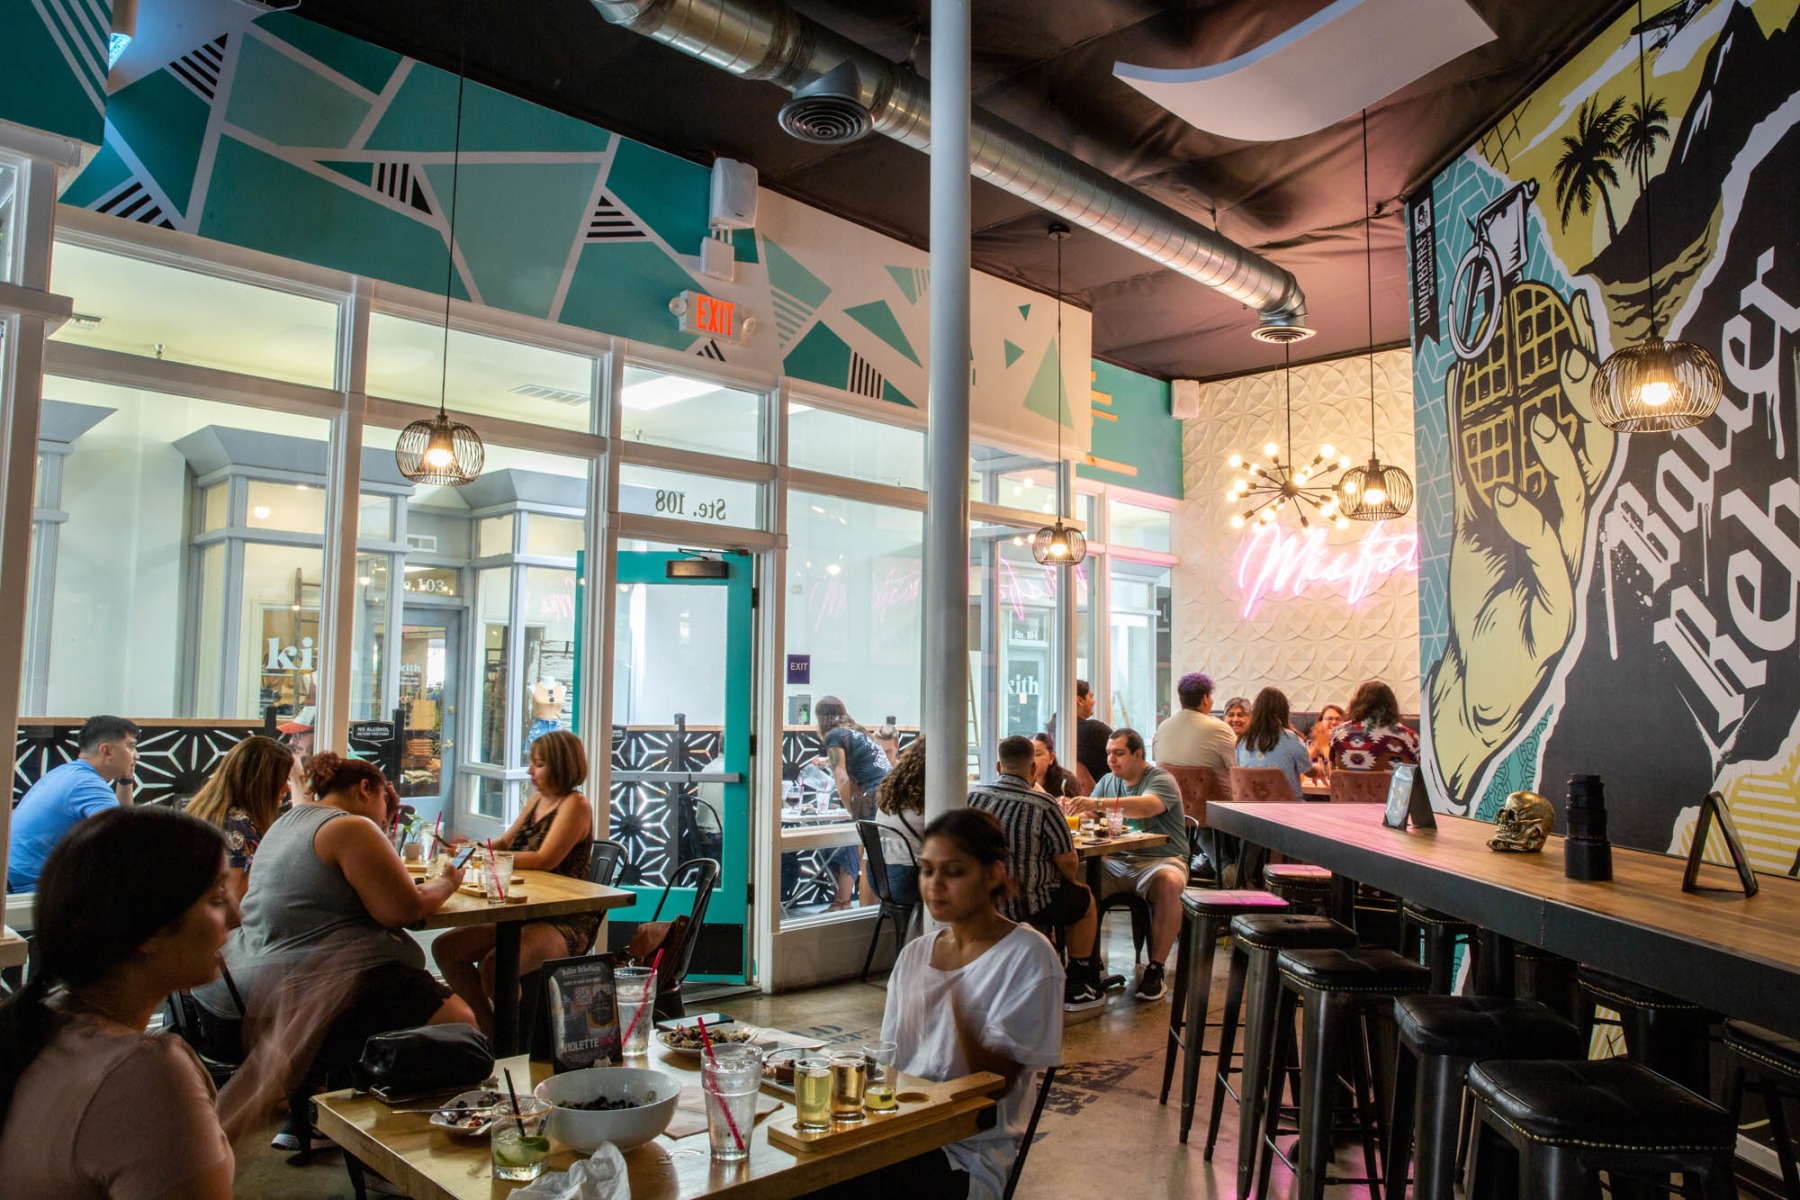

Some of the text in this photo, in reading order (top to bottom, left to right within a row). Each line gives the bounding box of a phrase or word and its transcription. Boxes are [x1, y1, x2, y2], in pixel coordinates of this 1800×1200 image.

[697, 293, 736, 336] EXIT
[417, 578, 445, 593] 103
[1026, 630, 1038, 640] 104
[265, 637, 316, 670] ki
[790, 662, 809, 671] EXIT
